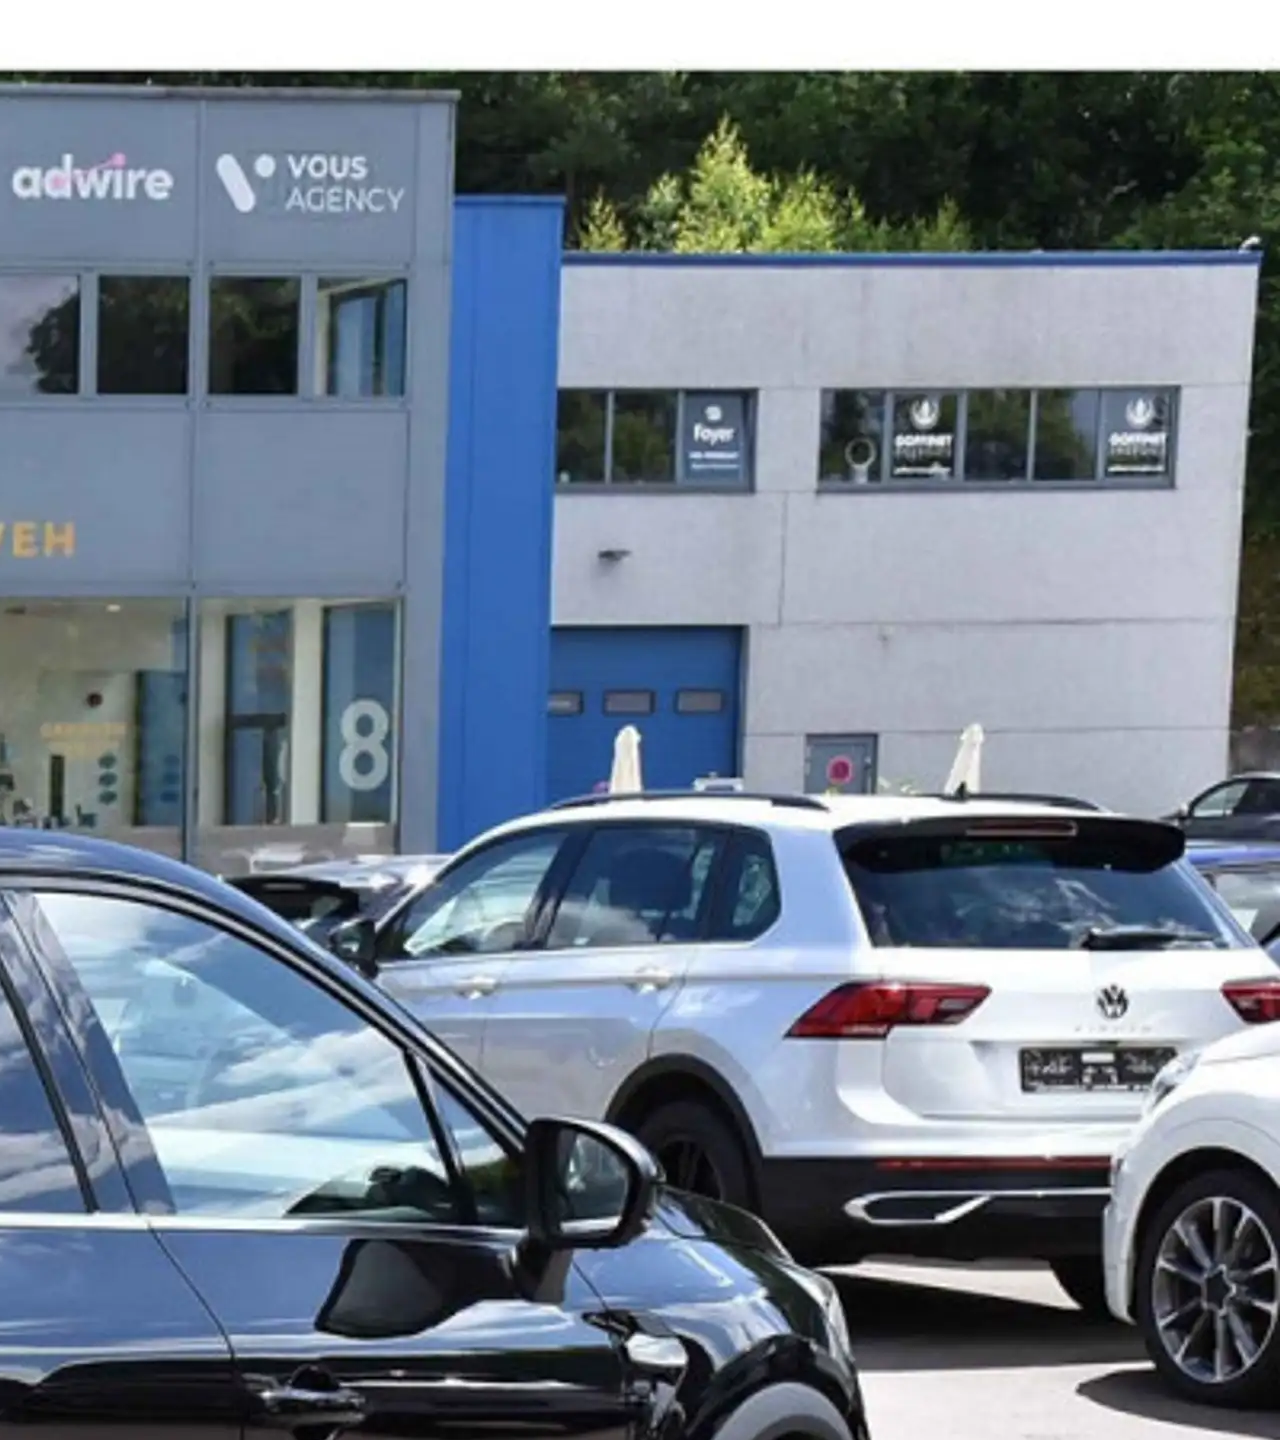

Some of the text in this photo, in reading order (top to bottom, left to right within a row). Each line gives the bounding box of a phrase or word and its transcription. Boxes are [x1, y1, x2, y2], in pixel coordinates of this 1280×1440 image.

[13, 153, 173, 199] adwire
[287, 154, 368, 180] VOUS
[286, 187, 405, 213] AGENCY
[340, 700, 389, 790] 8
